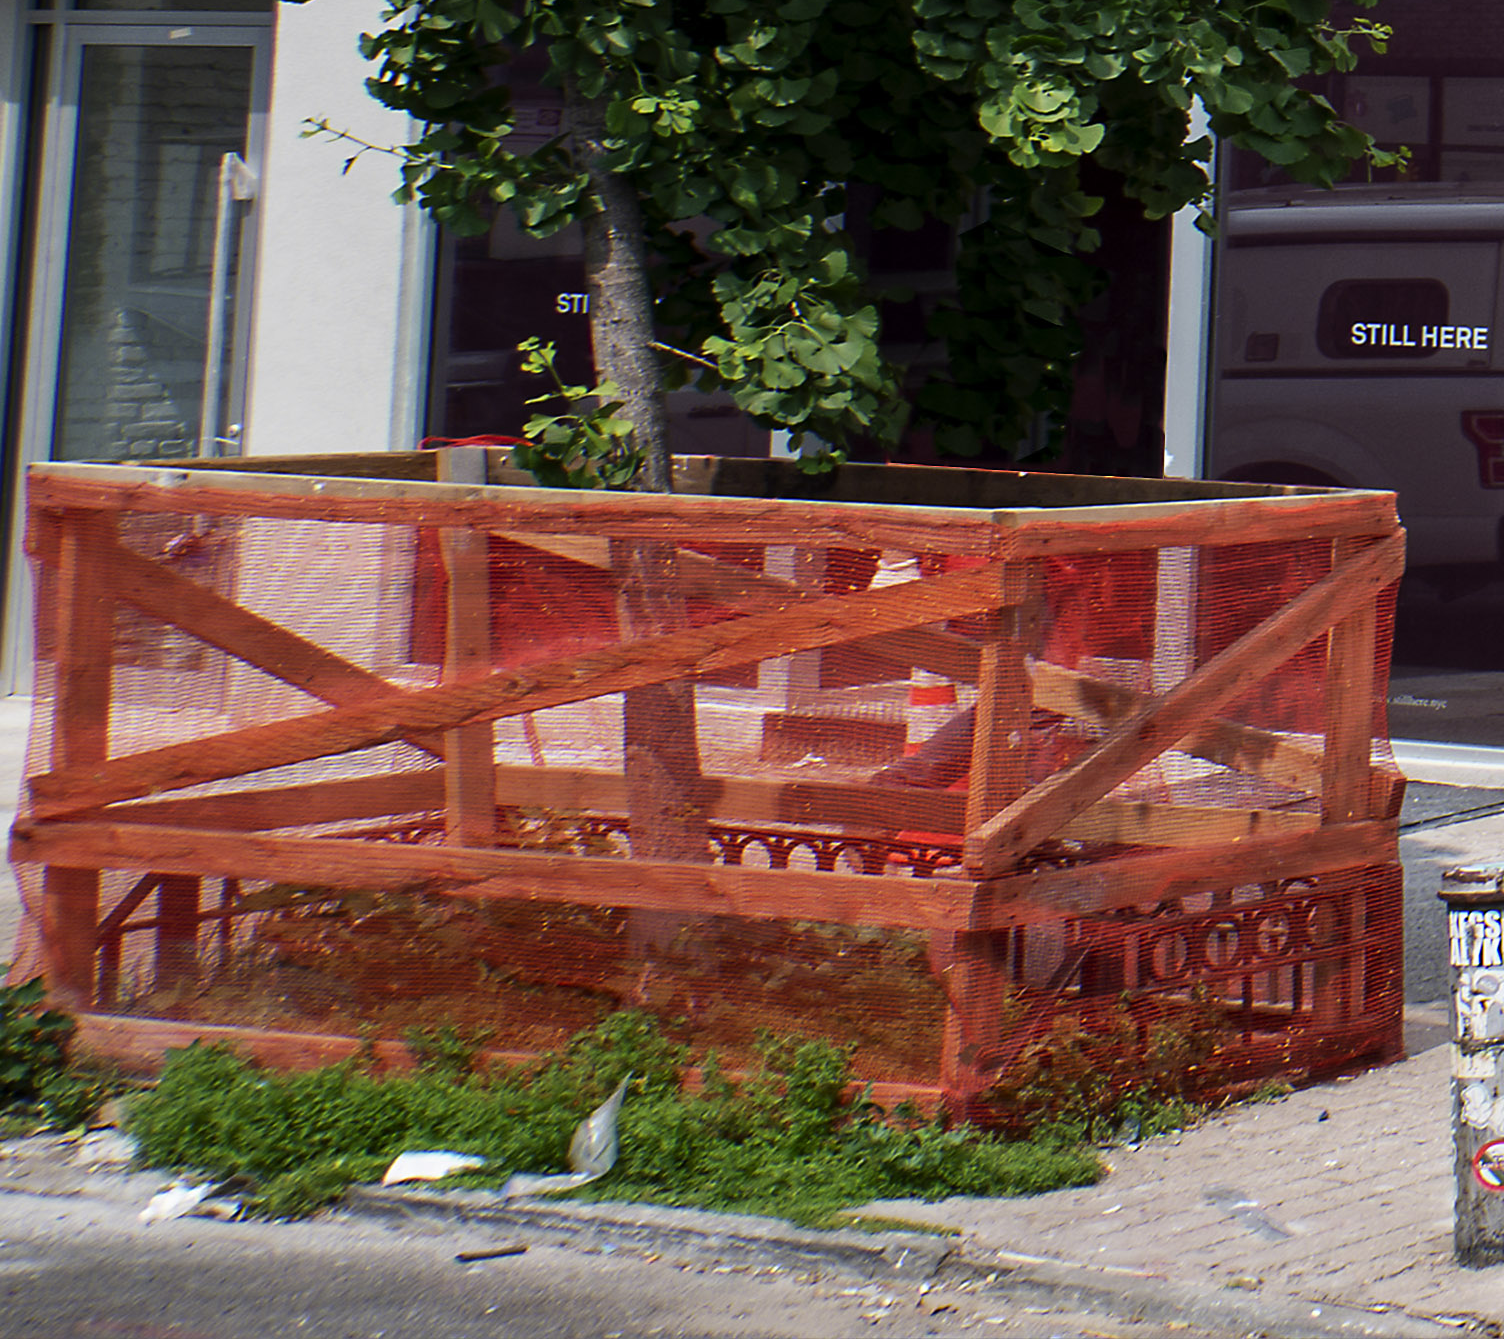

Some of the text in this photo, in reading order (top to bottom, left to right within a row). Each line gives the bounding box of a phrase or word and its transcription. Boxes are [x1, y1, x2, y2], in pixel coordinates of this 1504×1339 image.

[556, 293, 590, 314] STI
[1351, 322, 1488, 350] STILL HERE
